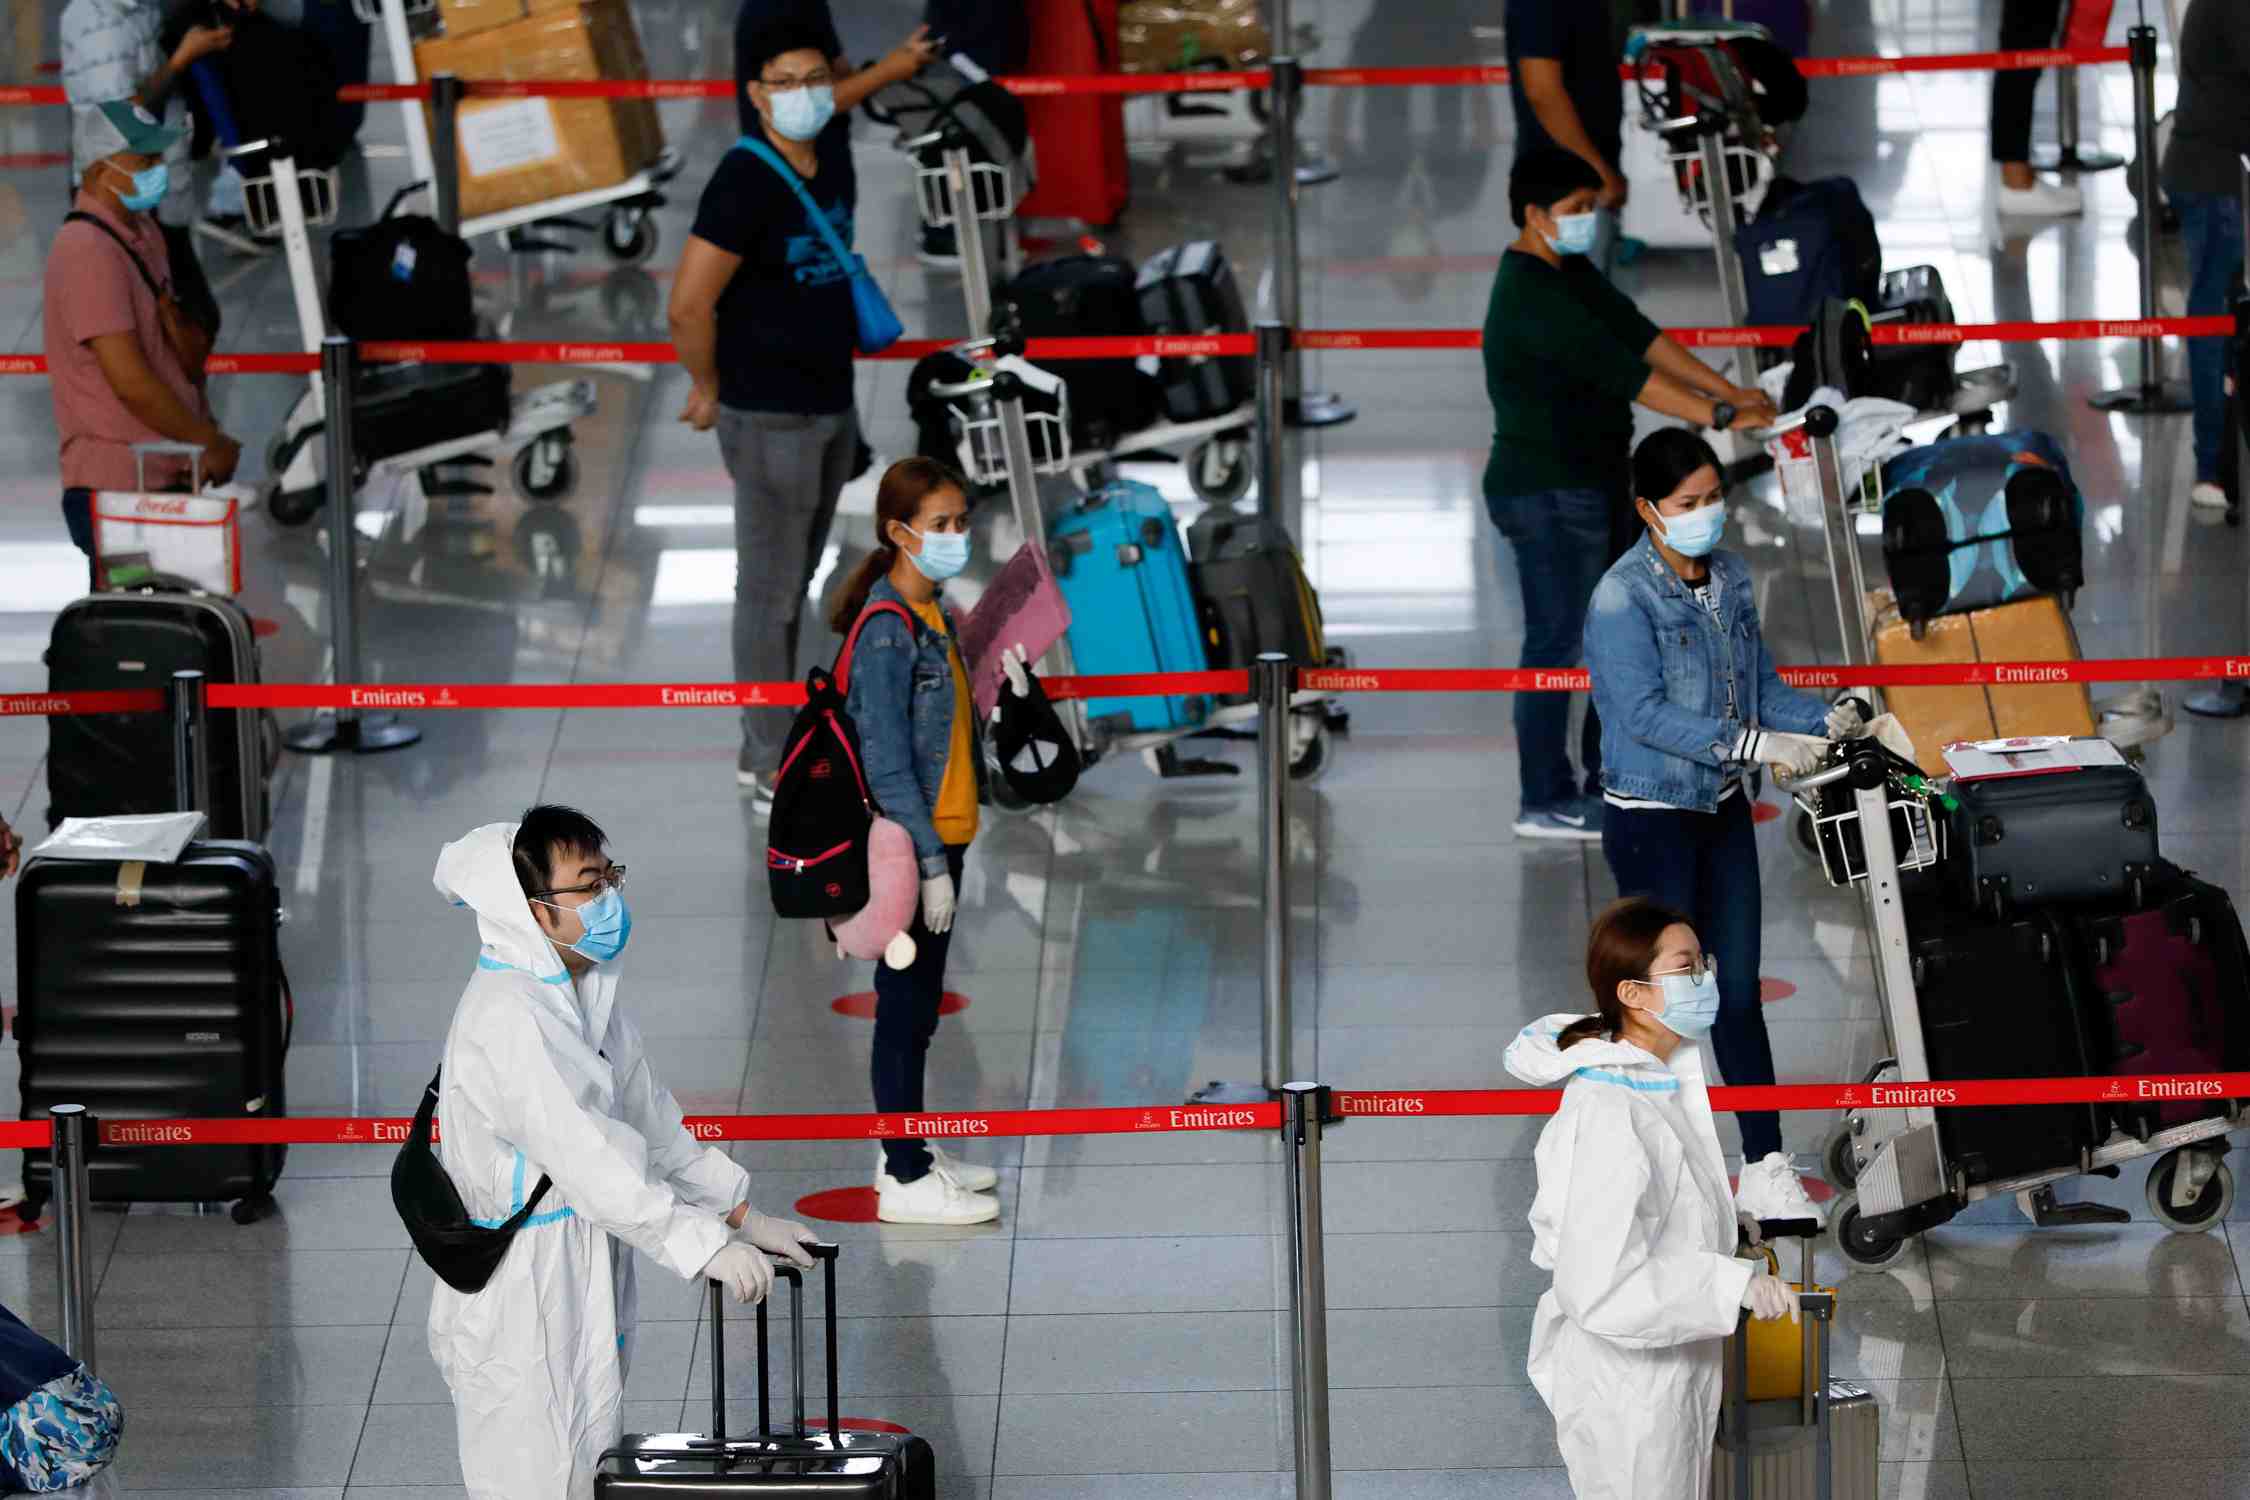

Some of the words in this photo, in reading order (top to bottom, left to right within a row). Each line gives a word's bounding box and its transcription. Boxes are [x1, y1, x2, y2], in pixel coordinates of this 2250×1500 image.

[1304, 671, 1379, 689] Emirates
[1535, 672, 1591, 689] Emirat
[1995, 662, 2068, 682] Emirates
[351, 687, 425, 706] Emirates
[662, 686, 736, 705] Emirates
[1872, 1085, 1956, 1105] Emirates
[2138, 1080, 2223, 1098] Emirates
[1341, 1095, 1424, 1114] Emirates
[904, 1115, 988, 1136] Emirates
[1170, 1108, 1255, 1128] Emirates
[109, 1123, 193, 1142] Emirates
